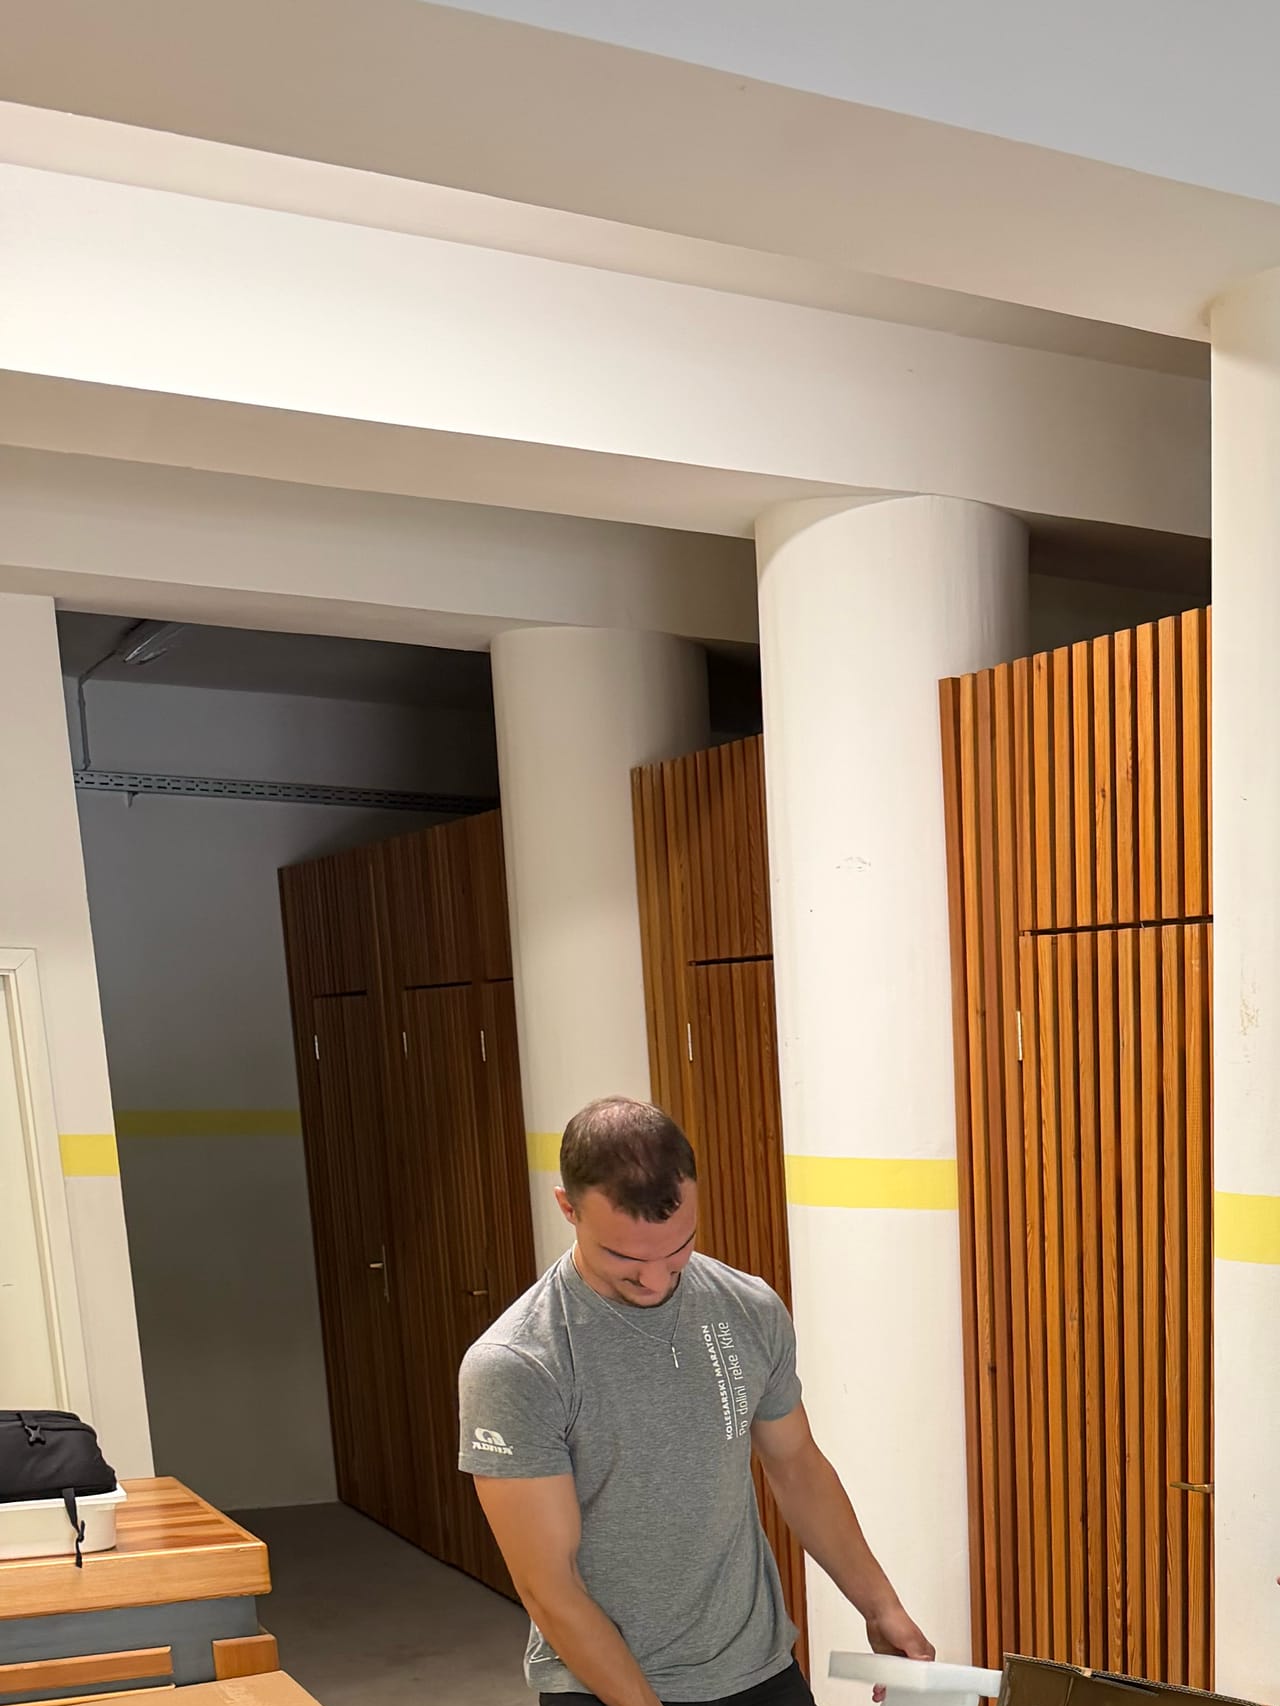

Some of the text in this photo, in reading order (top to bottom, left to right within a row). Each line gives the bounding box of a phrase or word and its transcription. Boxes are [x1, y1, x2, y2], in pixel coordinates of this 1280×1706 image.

[717, 1321, 735, 1348] Krke
[728, 1353, 743, 1379] reke
[701, 1324, 733, 1440] KOLESARSKI MARATON
